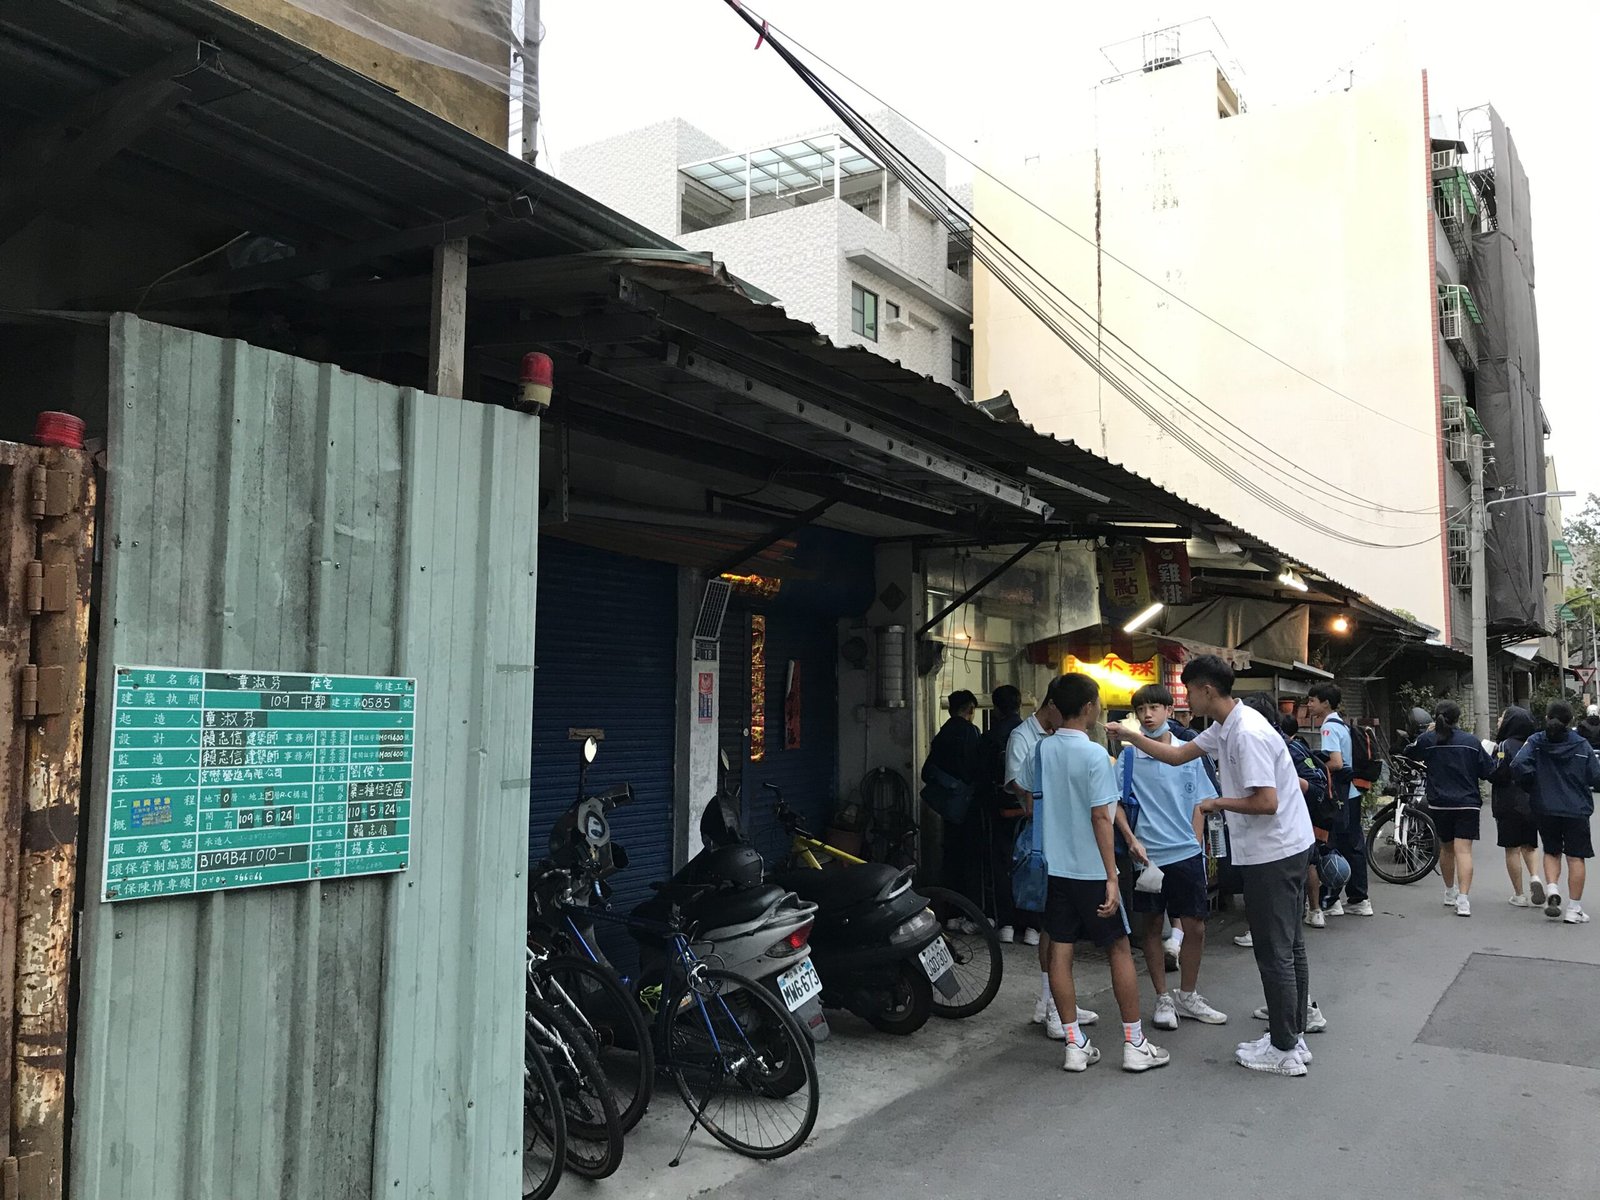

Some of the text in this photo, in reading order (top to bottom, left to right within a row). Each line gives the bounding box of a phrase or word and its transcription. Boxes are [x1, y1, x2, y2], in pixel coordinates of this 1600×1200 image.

[121, 674, 200, 686] 工程名稱
[121, 693, 200, 705] 建築執照
[119, 712, 199, 725] 起造人
[118, 732, 198, 745] 設計人
[117, 751, 197, 765] 監造人
[116, 774, 196, 787] 承造人
[112, 838, 193, 854] 服務電話
[110, 860, 193, 876] 環保管制編號
